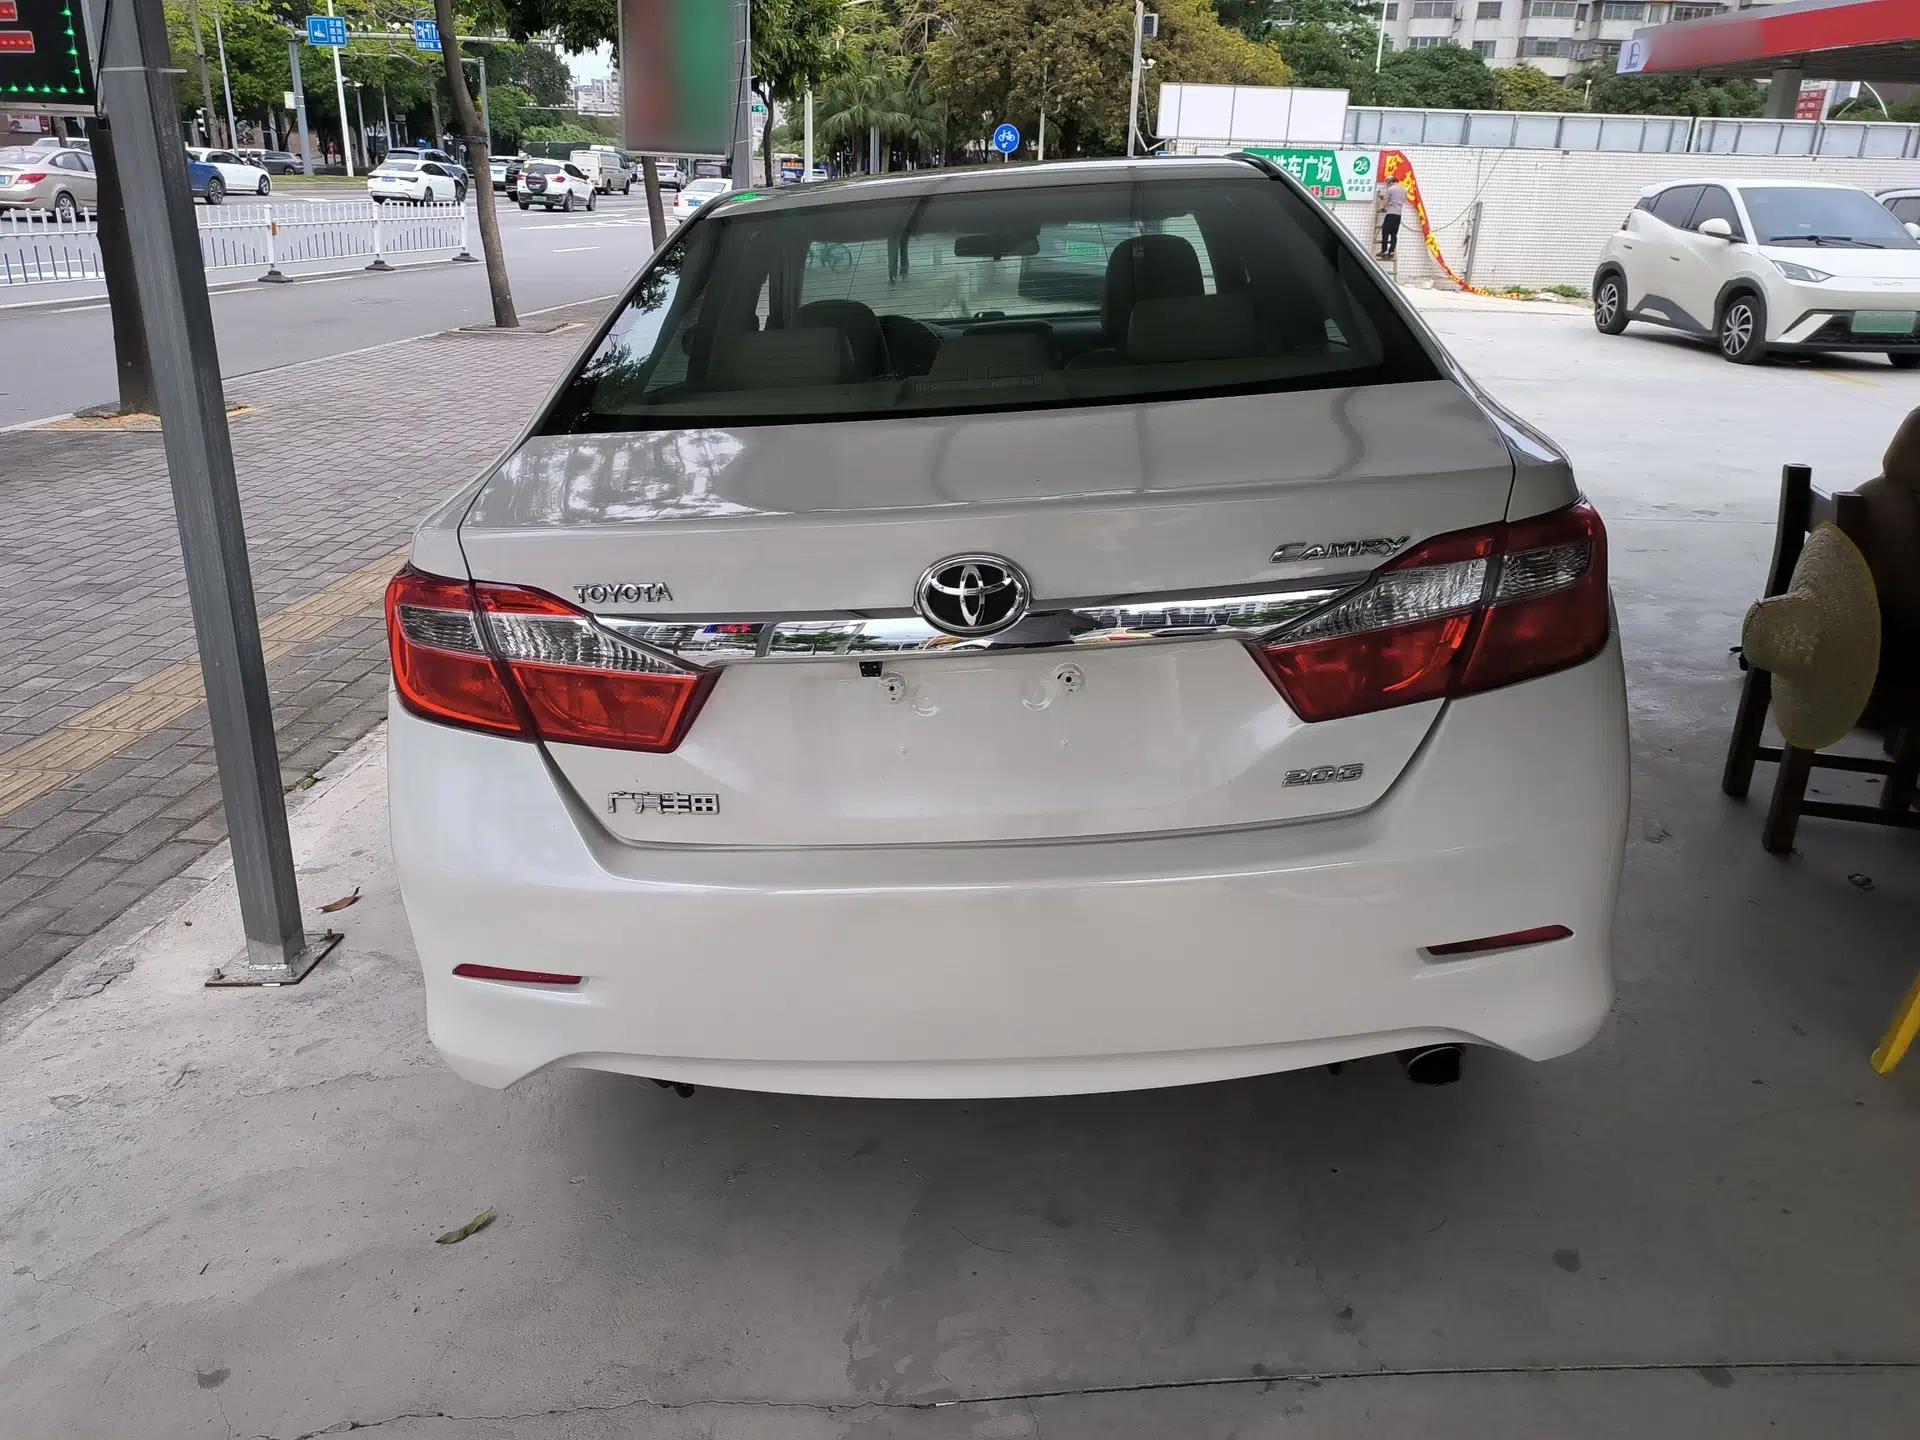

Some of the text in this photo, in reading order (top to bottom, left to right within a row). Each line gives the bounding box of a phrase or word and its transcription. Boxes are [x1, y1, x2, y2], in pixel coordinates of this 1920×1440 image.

[1269, 536, 1410, 563] CAMRY
[573, 582, 674, 604] TOYOTA
[607, 791, 720, 815] 广汽丰田
